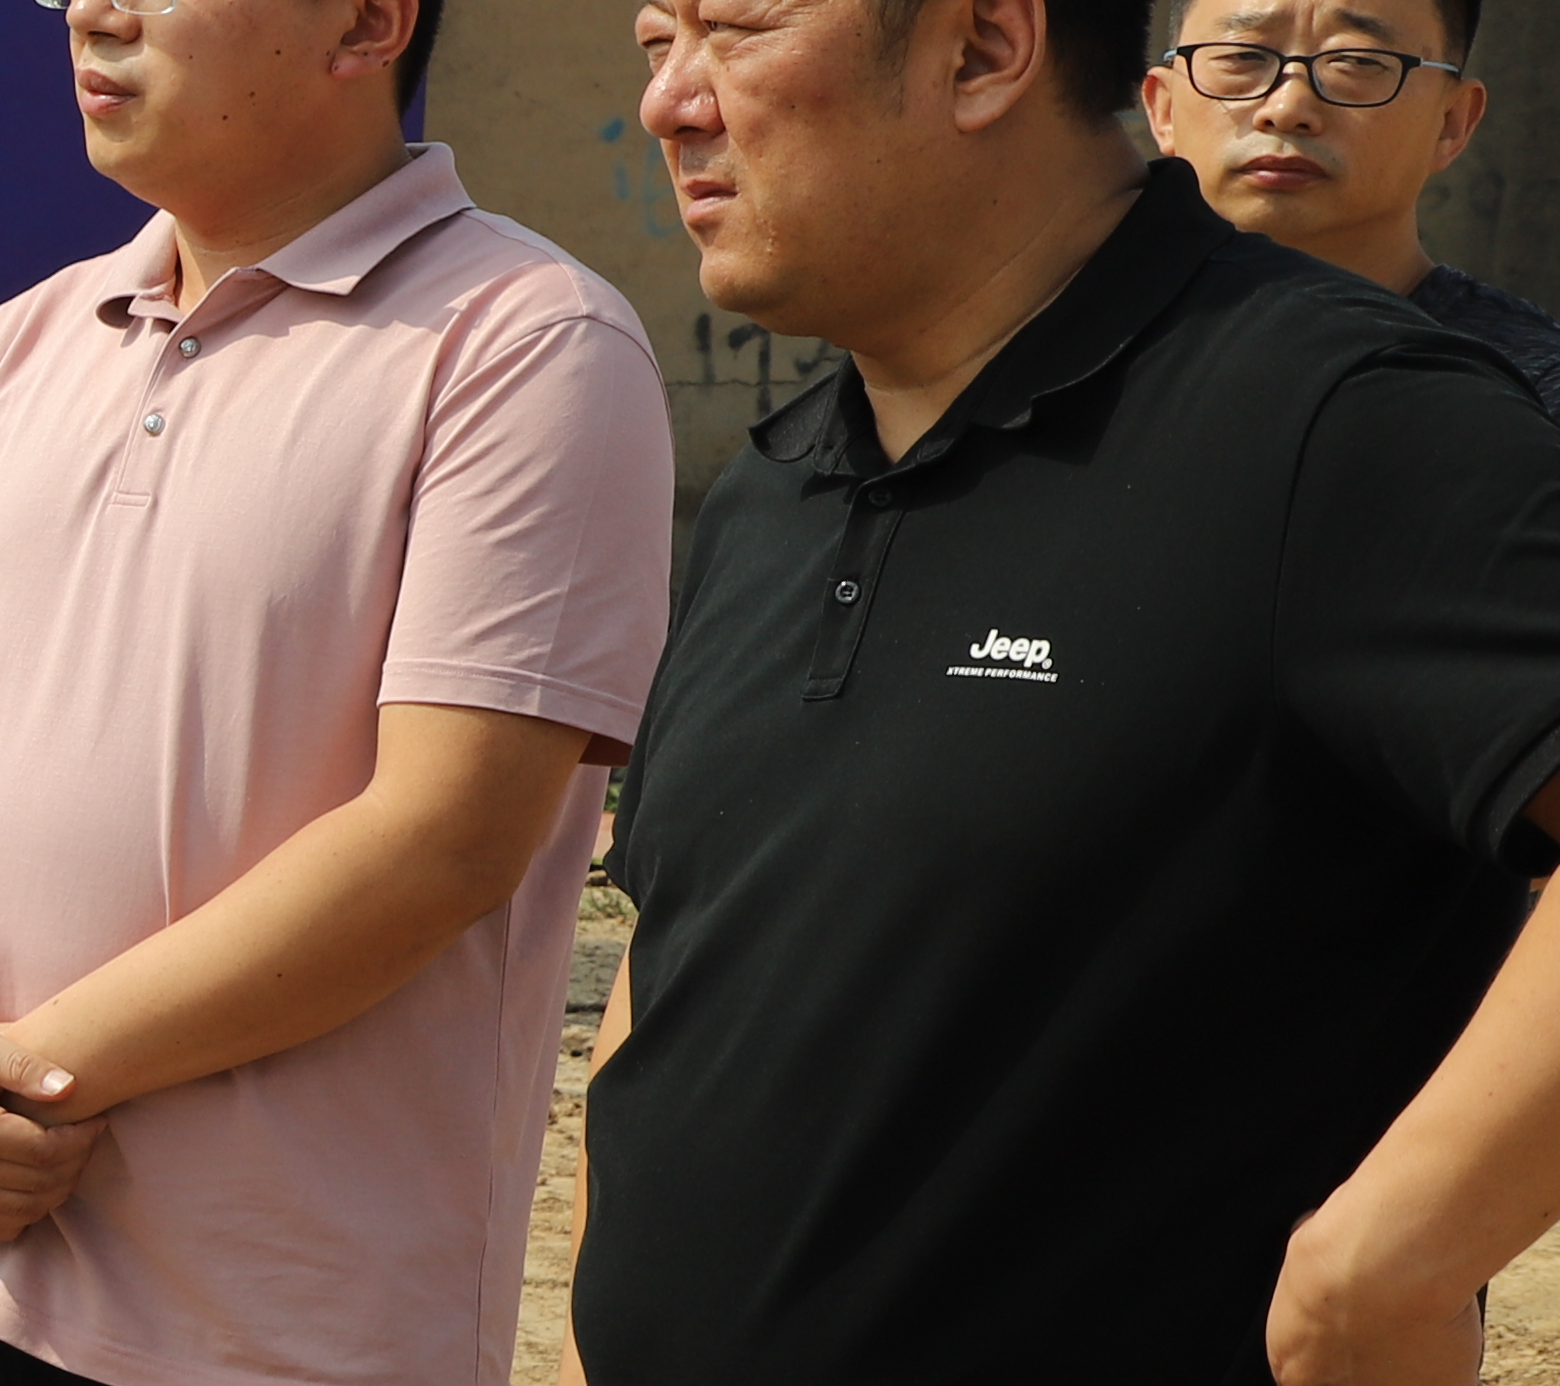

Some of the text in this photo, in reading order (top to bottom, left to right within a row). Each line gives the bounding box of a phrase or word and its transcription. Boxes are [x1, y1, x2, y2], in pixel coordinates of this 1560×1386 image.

[969, 628, 1052, 669] Jeep
[946, 666, 1058, 683] XTREME PERFORMANCE
